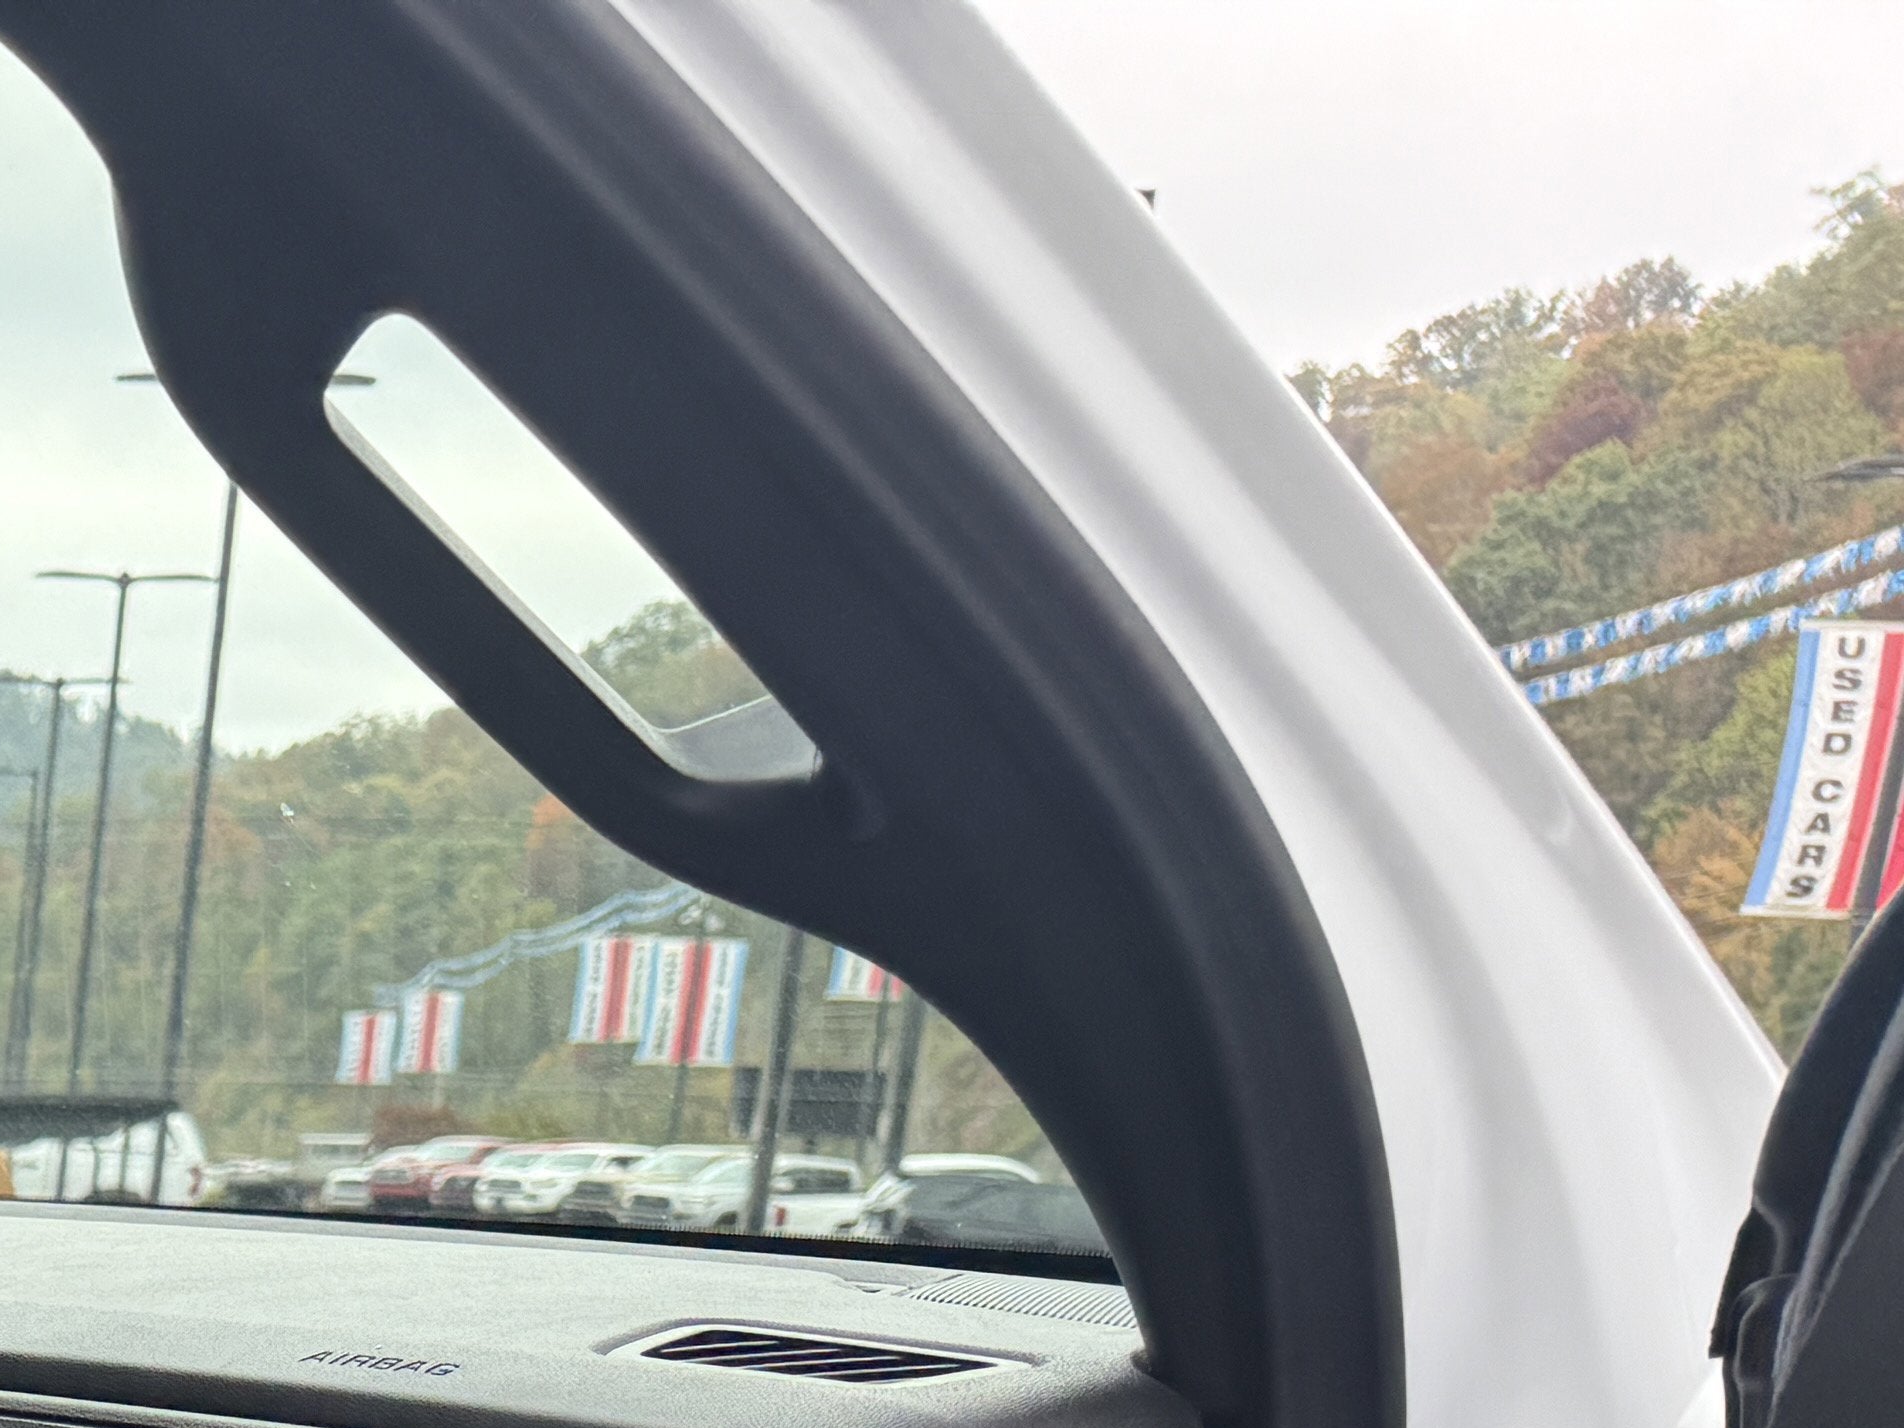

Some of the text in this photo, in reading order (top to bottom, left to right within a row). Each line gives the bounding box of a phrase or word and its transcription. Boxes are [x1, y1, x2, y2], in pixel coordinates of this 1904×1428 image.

[1785, 635, 1867, 900] USED CARS
[298, 1350, 461, 1377] AIRBAG
